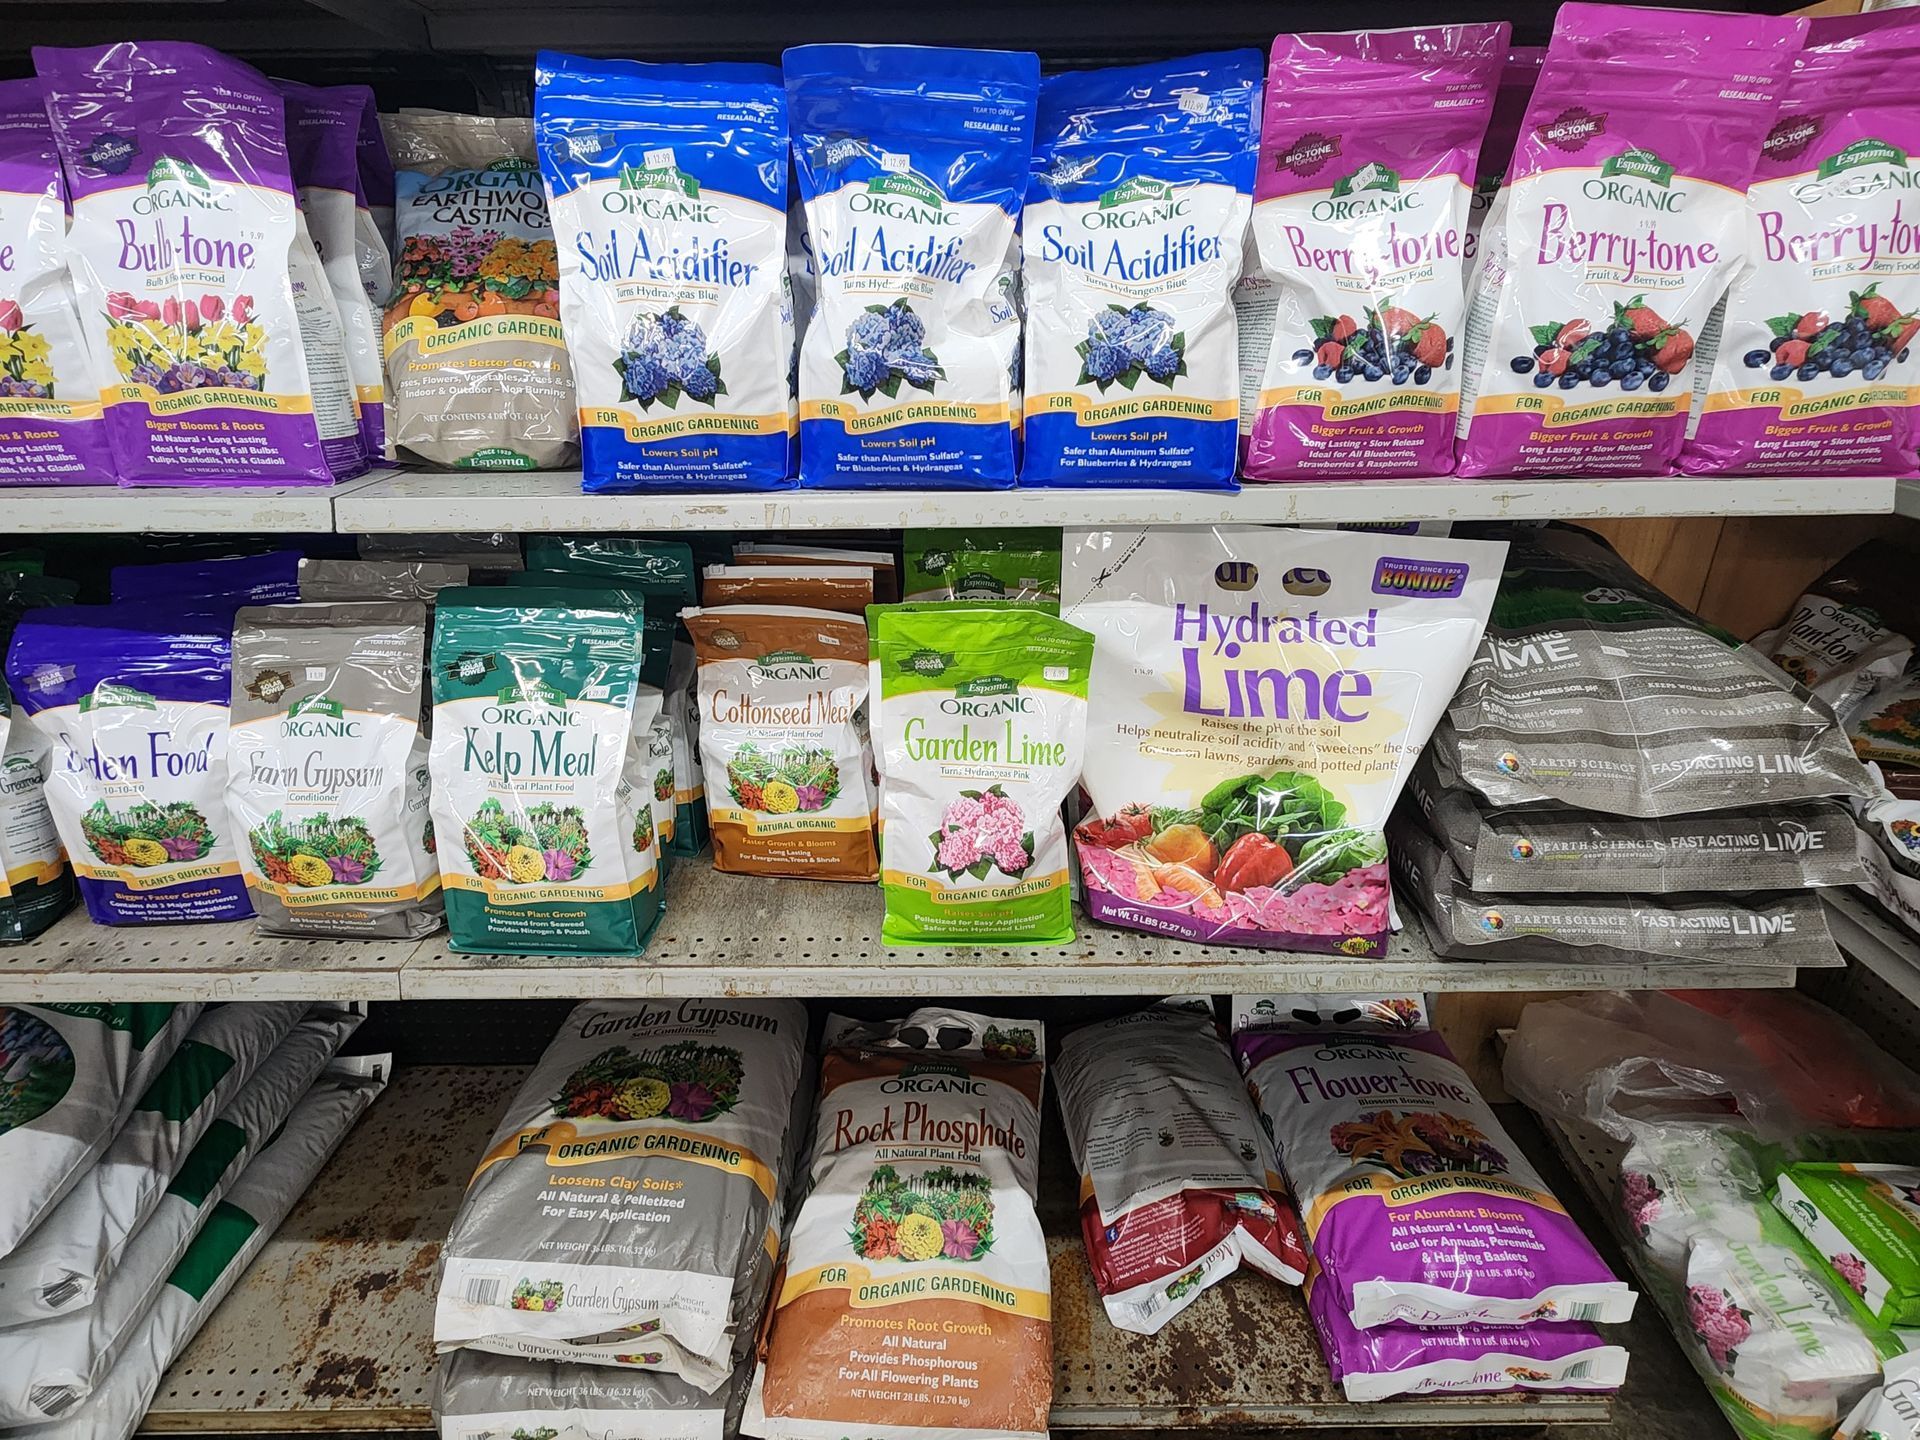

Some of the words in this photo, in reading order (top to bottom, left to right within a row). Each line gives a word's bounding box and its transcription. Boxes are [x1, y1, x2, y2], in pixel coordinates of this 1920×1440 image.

[1719, 90, 1763, 101] RESEALABLE
[998, 108, 1015, 116] OPEN
[964, 121, 1008, 132] RESEALABLE
[1548, 122, 1596, 139] BIO-TONE
[653, 153, 671, 163] 12.99
[1836, 150, 1894, 166] Espoma
[1616, 160, 1661, 176] Espoma
[1583, 180, 1686, 213] ORGANIC
[850, 193, 960, 226] ORGANIC
[116, 215, 254, 271] Bulb-tone
[1537, 203, 1719, 283] Berry-tone
[1043, 225, 1094, 272] Soil
[1104, 225, 1222, 281] Acidifier
[1586, 270, 1609, 280] Fruit
[1613, 272, 1620, 280] &
[1634, 276, 1656, 287] Berry
[1660, 277, 1684, 286] Food
[395, 322, 413, 342] FOR
[427, 323, 492, 347] ORGANIC
[122, 388, 142, 398] FOR
[156, 395, 201, 411] ORGANIC
[204, 393, 278, 408] GARDENING
[1050, 397, 1072, 407] FOR
[1084, 403, 1138, 421] ORGANIC
[1143, 401, 1212, 415] GARDENING
[146, 421, 177, 432] Bigger
[180, 422, 219, 430] Blooms
[222, 422, 230, 430] &
[235, 422, 265, 430] Roots
[1311, 425, 1345, 436] Bigger
[1377, 426, 1384, 434] &
[1388, 425, 1423, 433] Growth
[208, 436, 231, 445] Long
[233, 436, 268, 445] Lasting
[1091, 432, 1127, 440] Lowers
[1130, 432, 1148, 440] Soil
[1152, 432, 1167, 442] pH
[1139, 459, 1191, 468] Hydrangeas
[1384, 562, 1418, 572] TRUSTED
[1420, 566, 1442, 574] SINCE
[1380, 570, 1455, 593] BONIDE
[1173, 602, 1378, 656] Hydrated
[1820, 605, 1884, 642] ORGANIC
[968, 683, 1008, 693] Espoma
[1182, 642, 1372, 723] Lime
[712, 689, 812, 724] Cottonseed
[940, 697, 1034, 717] ORGANIC
[1664, 707, 1696, 716] 100%
[1701, 702, 1793, 716] GUARANTEED
[1201, 718, 1239, 730] Raises
[1243, 721, 1261, 732] the
[1266, 723, 1282, 737] pH
[1285, 724, 1294, 735] of
[1297, 724, 1316, 736] the
[1320, 725, 1341, 737] soil
[904, 718, 997, 762] Garden
[1005, 719, 1066, 766] Lime
[1117, 724, 1151, 737] Helps
[1154, 728, 1215, 743] neutralize
[1218, 734, 1239, 746] soil
[1243, 736, 1284, 750] acidity
[1288, 741, 1305, 752] and
[148, 732, 214, 778] Food
[464, 726, 521, 782] Kelp
[531, 730, 598, 776] Meal
[1204, 748, 1243, 764] lawns,
[1247, 754, 1294, 768] gardens
[1297, 757, 1317, 768] and
[1321, 758, 1361, 772] potted
[1364, 759, 1399, 773] plants
[1529, 758, 1577, 768] EARTH
[1581, 761, 1636, 772] SCIENCE
[1652, 760, 1692, 774] FAST
[1698, 755, 1754, 769] ACTING
[1758, 754, 1821, 776] LIME
[104, 784, 144, 794] 10-10-10
[289, 793, 339, 801] Conditioner
[757, 823, 793, 833] NATURAL
[797, 820, 836, 828] ORGANIC
[139, 875, 175, 887] PLANTS
[177, 866, 221, 879] QUICKLY
[484, 906, 525, 917] Promotes
[1514, 915, 1560, 924] EARTH
[1563, 915, 1627, 925] SCIENCE
[1102, 906, 1116, 916] Net
[1118, 909, 1131, 919] Wt.
[1132, 913, 1139, 921] 5
[1140, 914, 1158, 927] LBS
[1158, 920, 1179, 932] (2.27
[1180, 925, 1197, 937] kg.)
[1641, 915, 1677, 928] FAST
[1680, 917, 1730, 928] ACTING
[1732, 913, 1796, 934] LIME
[580, 1005, 670, 1039] Garden
[677, 999, 778, 1035] Gypsum
[1315, 1050, 1416, 1063] ORGANIC
[881, 1079, 988, 1096] ORGANIC
[1286, 1065, 1471, 1104] Flower-tone
[835, 1105, 896, 1151] Rock
[903, 1102, 1025, 1159] Phosphate
[559, 1135, 641, 1159] ORGANIC
[644, 1135, 741, 1166] GARDENING
[875, 1150, 888, 1159] All
[891, 1149, 926, 1158] Natural
[930, 1150, 954, 1159] Plant
[958, 1151, 980, 1162] Food
[550, 1175, 605, 1187] Loosens
[610, 1176, 639, 1191] Clay
[537, 1191, 555, 1201] All
[559, 1191, 608, 1203] Natural
[611, 1194, 621, 1204] &
[624, 1194, 685, 1208] Pelletized
[542, 1206, 565, 1216] For
[568, 1207, 596, 1221] Easy
[599, 1208, 670, 1223] Application
[1389, 1212, 1411, 1222] For
[1414, 1208, 1475, 1220] Abundant
[1479, 1208, 1524, 1221] Blooms
[820, 1268, 847, 1284] FOR
[859, 1278, 925, 1300] ORGANIC
[931, 1276, 1015, 1306] GARDENING
[567, 1284, 609, 1308] Garden
[613, 1287, 658, 1312] Gypsum
[841, 1315, 903, 1330] Promotes
[908, 1318, 938, 1332] Root
[943, 1321, 992, 1335] Growth
[882, 1336, 898, 1347] All
[902, 1337, 946, 1349] Natural
[850, 1351, 898, 1365] Provides
[902, 1354, 977, 1370] Phosphorous
[851, 1389, 867, 1398] NET
[869, 1390, 901, 1400] WEIGHT
[904, 1393, 913, 1401] 28
[915, 1393, 930, 1402] LBS.
[933, 1395, 956, 1405] (12.70
[958, 1398, 970, 1407] kg)
